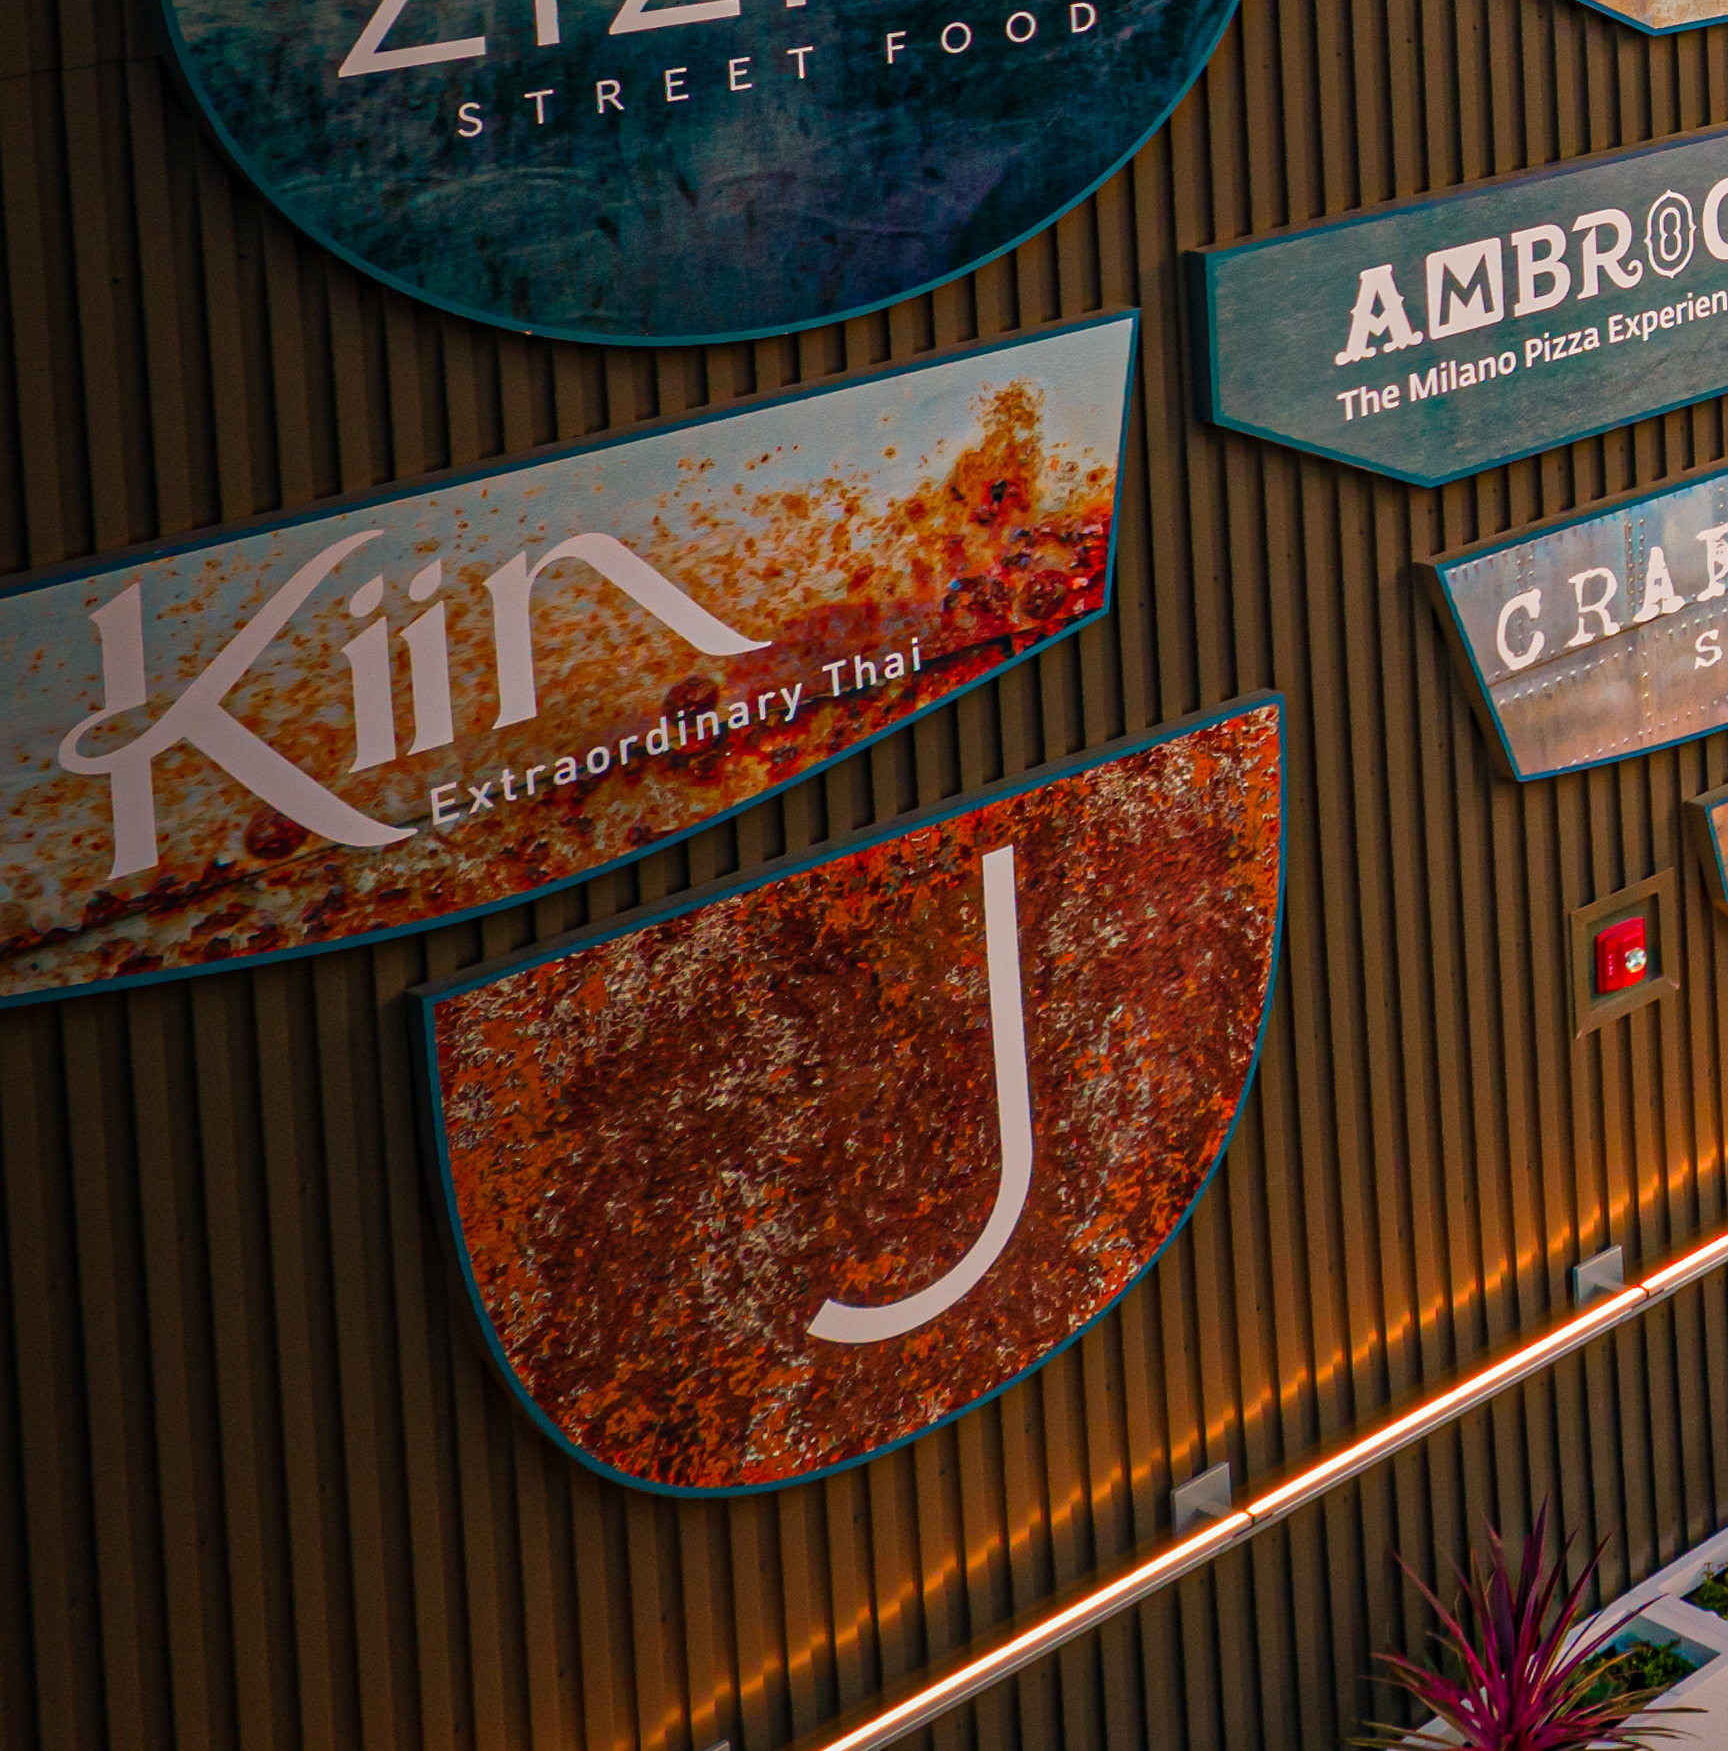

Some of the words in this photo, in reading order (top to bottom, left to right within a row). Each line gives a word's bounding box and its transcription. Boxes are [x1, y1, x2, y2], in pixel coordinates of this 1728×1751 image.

[455, 46, 814, 139] STREET
[886, 0, 1098, 65] FOOD
[1337, 384, 1401, 423] The
[1408, 348, 1517, 405] Milano
[1525, 326, 1602, 369] Pizza
[58, 529, 773, 881] Kiin
[429, 682, 806, 826] Extraordinary
[822, 637, 923, 699] Thai
[806, 843, 1034, 1344] J
